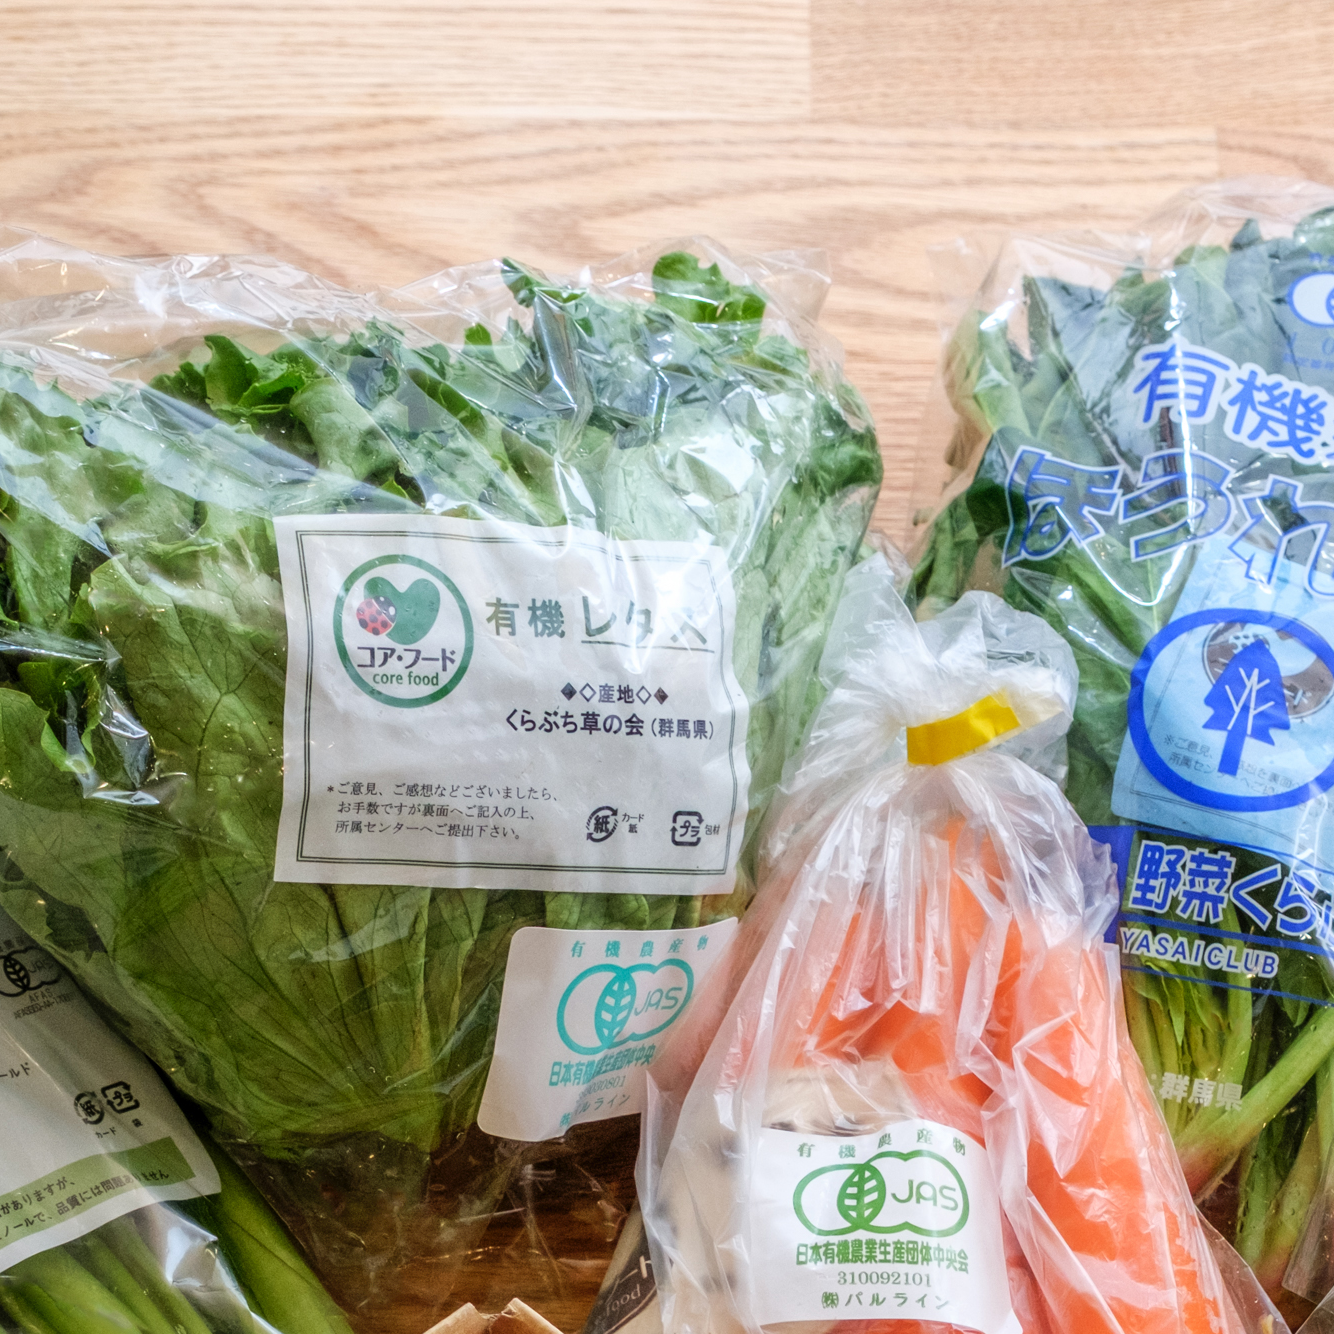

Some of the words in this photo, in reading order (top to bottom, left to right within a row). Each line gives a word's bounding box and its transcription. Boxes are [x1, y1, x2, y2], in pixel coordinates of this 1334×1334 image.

[485, 597, 565, 638] 有機
[357, 646, 456, 671] コア・フード
[372, 672, 404, 687] core
[408, 670, 439, 687] food
[593, 815, 610, 834] 紙
[679, 820, 700, 838] プラ
[571, 934, 709, 958] 有機農産物
[634, 986, 683, 1016] JAS
[797, 1128, 967, 1159] 有機農産物
[891, 1179, 959, 1211] JAS
[795, 1239, 969, 1274] 日本有機農業生産団体中央会
[838, 1270, 932, 1288] 310092101
